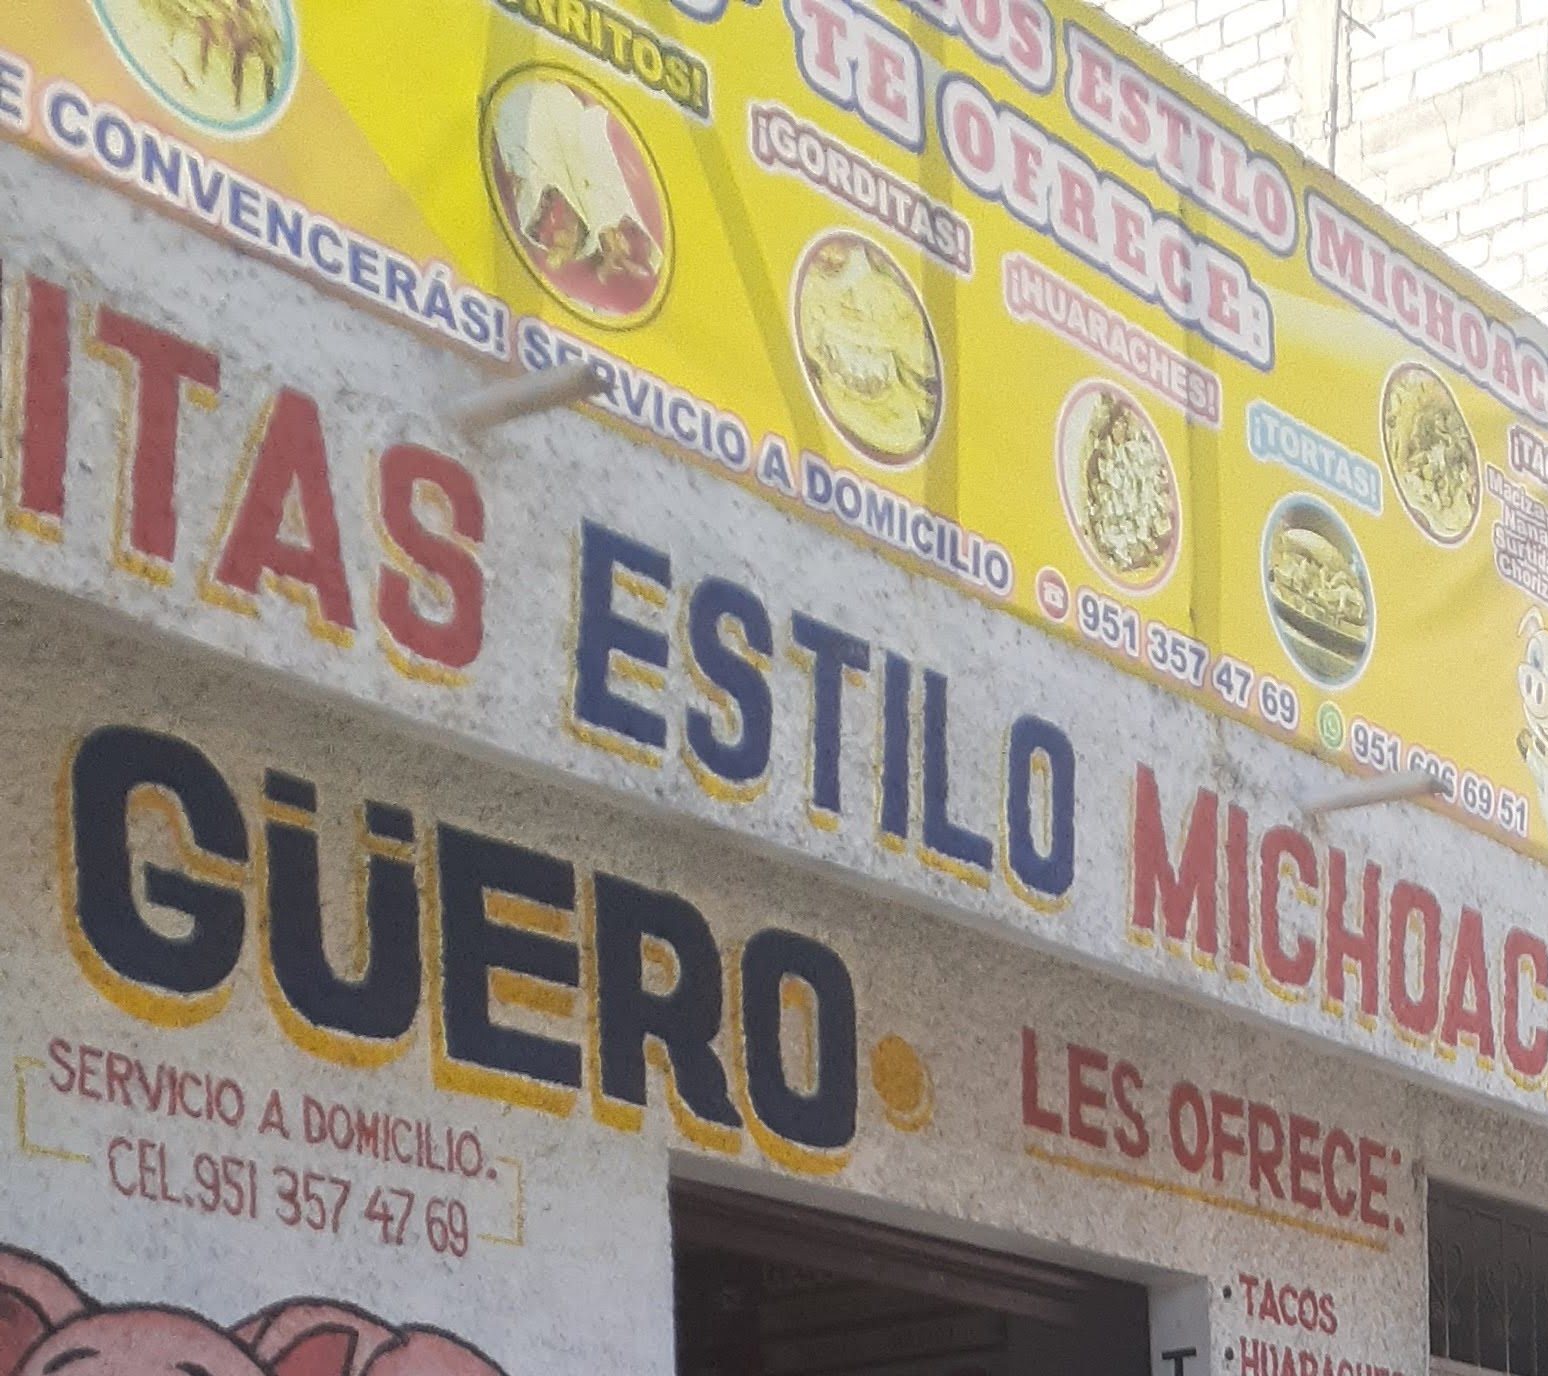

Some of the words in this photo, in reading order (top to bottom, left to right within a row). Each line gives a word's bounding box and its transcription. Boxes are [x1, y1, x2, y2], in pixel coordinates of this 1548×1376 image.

[804, 2, 909, 121] TE
[756, 115, 966, 264] ¡GORDITAS!
[1077, 38, 1291, 236] ESTILO
[50, 91, 508, 353] CONVENCERÁS!
[522, 325, 746, 465] SERVICIO
[764, 441, 791, 489] A
[806, 460, 1011, 591] DOMICILIO
[1009, 267, 1215, 416] ¡HUARACHES!
[1254, 406, 1378, 505] ¡TORTAS!
[575, 518, 1077, 897] ESTILO
[1080, 595, 1138, 655] 951
[1150, 629, 1206, 687] 357
[1215, 661, 1251, 706] 47
[1261, 680, 1296, 726] 69
[1352, 723, 1400, 771] 951
[1462, 780, 1493, 816] 69
[1500, 794, 1528, 834] 51
[68, 725, 860, 1152] GÜERO
[47, 1037, 245, 1128] SERVICIO
[261, 1100, 290, 1141] A
[1021, 1026, 1150, 1160] LES
[273, 1165, 351, 1236] 357
[364, 1187, 414, 1248] 47
[426, 1199, 469, 1259] 69
[1238, 1273, 1338, 1336] TACOS
